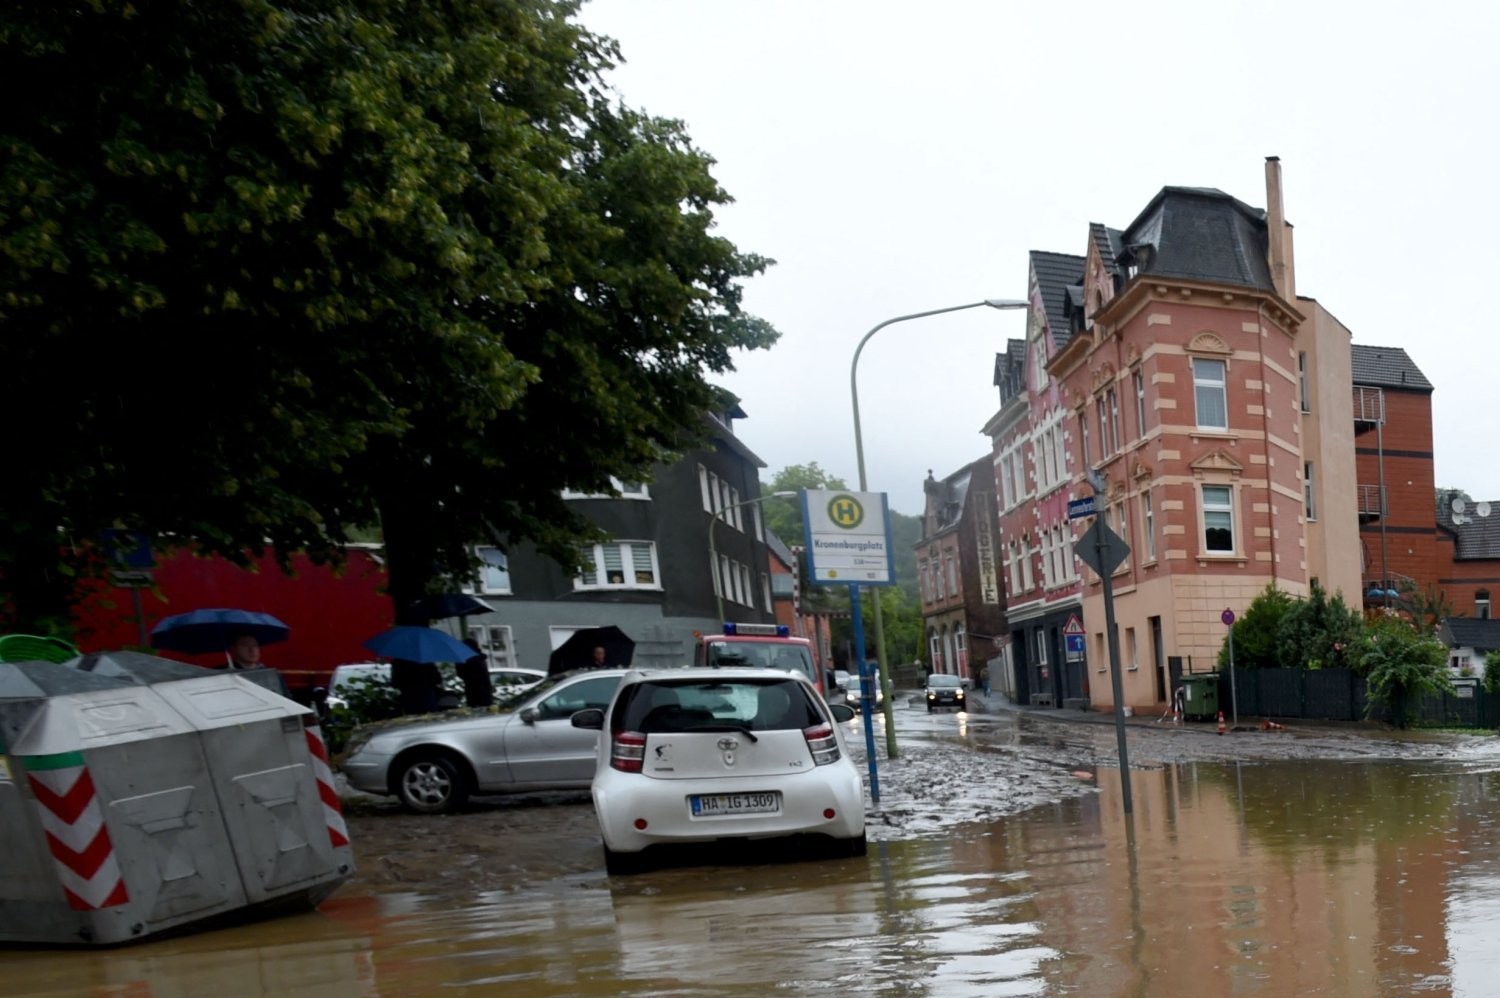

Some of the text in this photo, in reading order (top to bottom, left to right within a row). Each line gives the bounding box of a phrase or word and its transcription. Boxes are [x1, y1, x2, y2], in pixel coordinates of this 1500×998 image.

[838, 503, 855, 521] H
[702, 795, 774, 810] HA IG 1309
